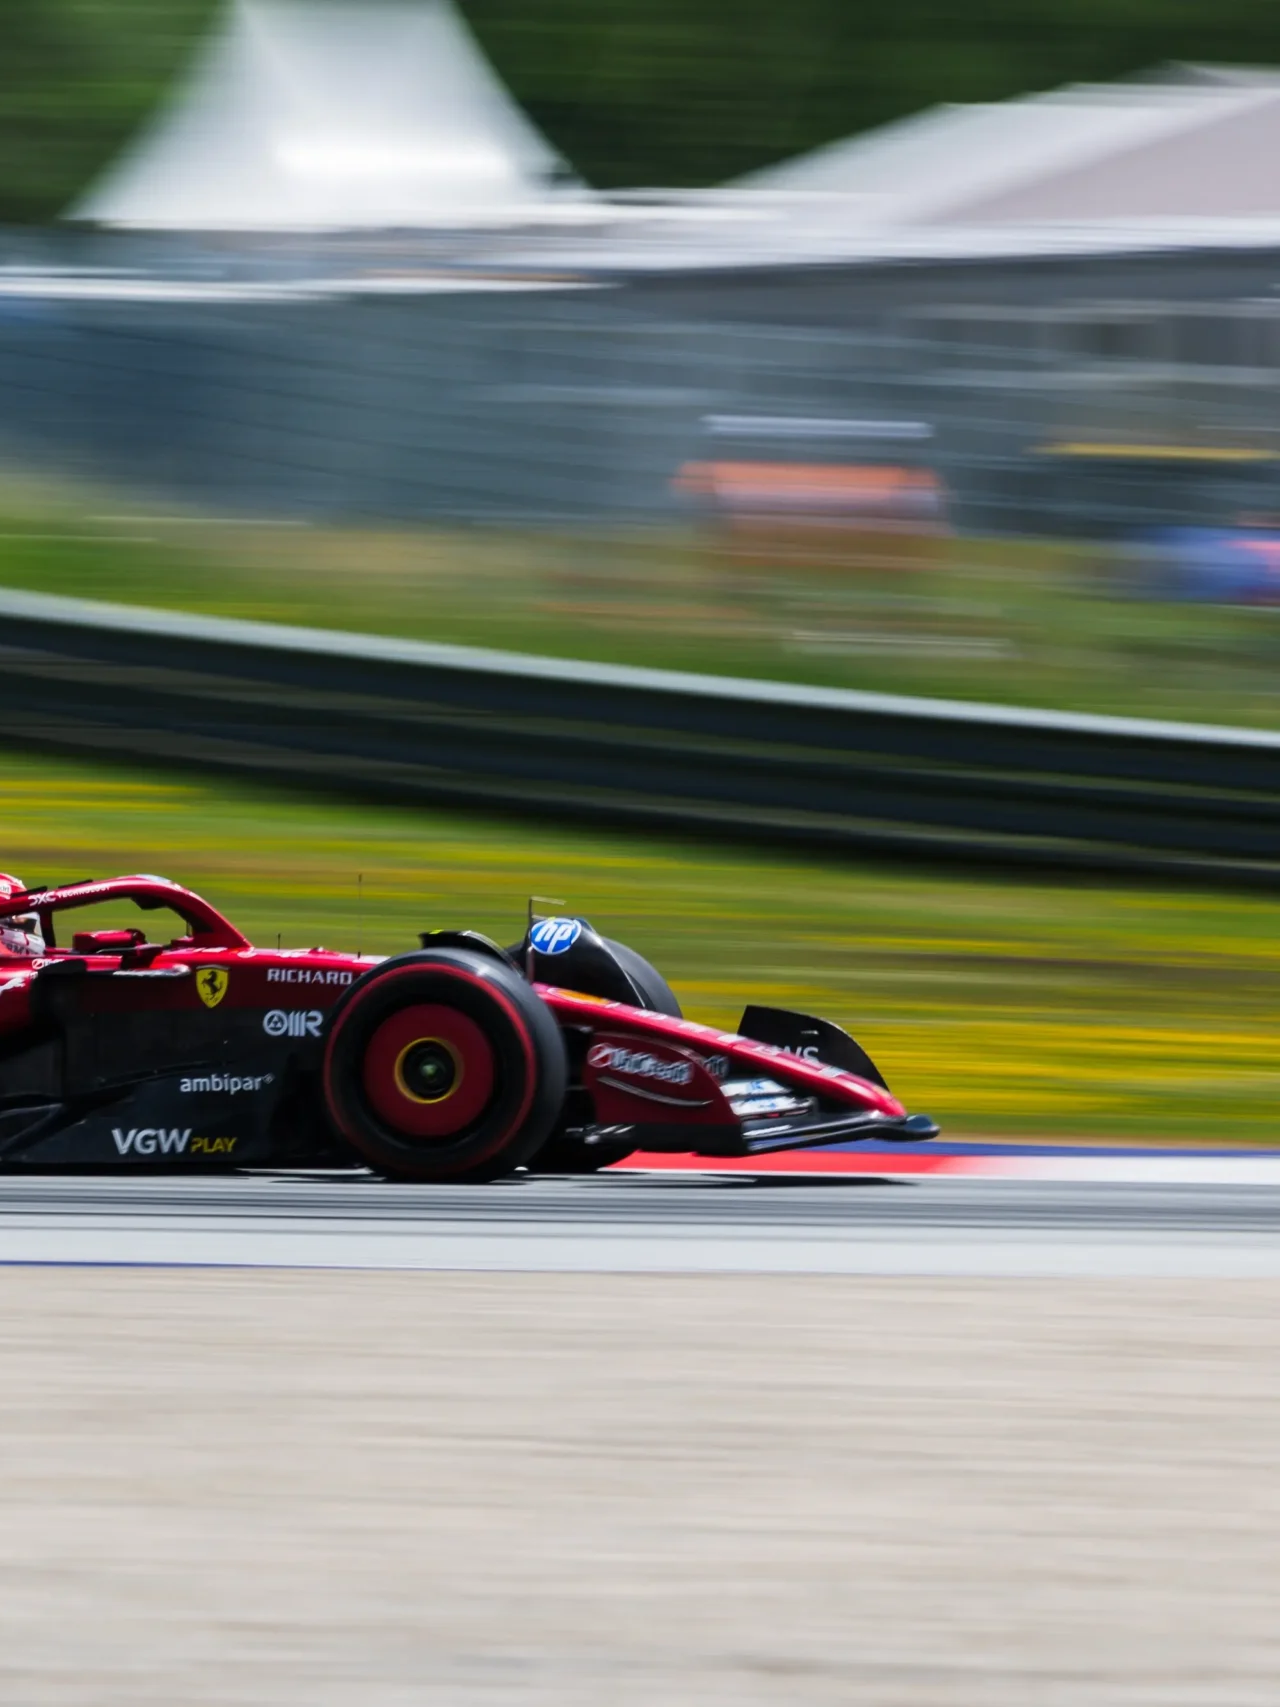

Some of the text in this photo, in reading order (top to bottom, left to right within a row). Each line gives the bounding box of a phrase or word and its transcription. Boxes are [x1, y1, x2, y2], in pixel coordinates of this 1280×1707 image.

[534, 918, 574, 954] hp
[267, 968, 353, 985] RICHARD
[180, 1073, 262, 1095] ambipar
[112, 1128, 238, 1154] VGW PLAY
